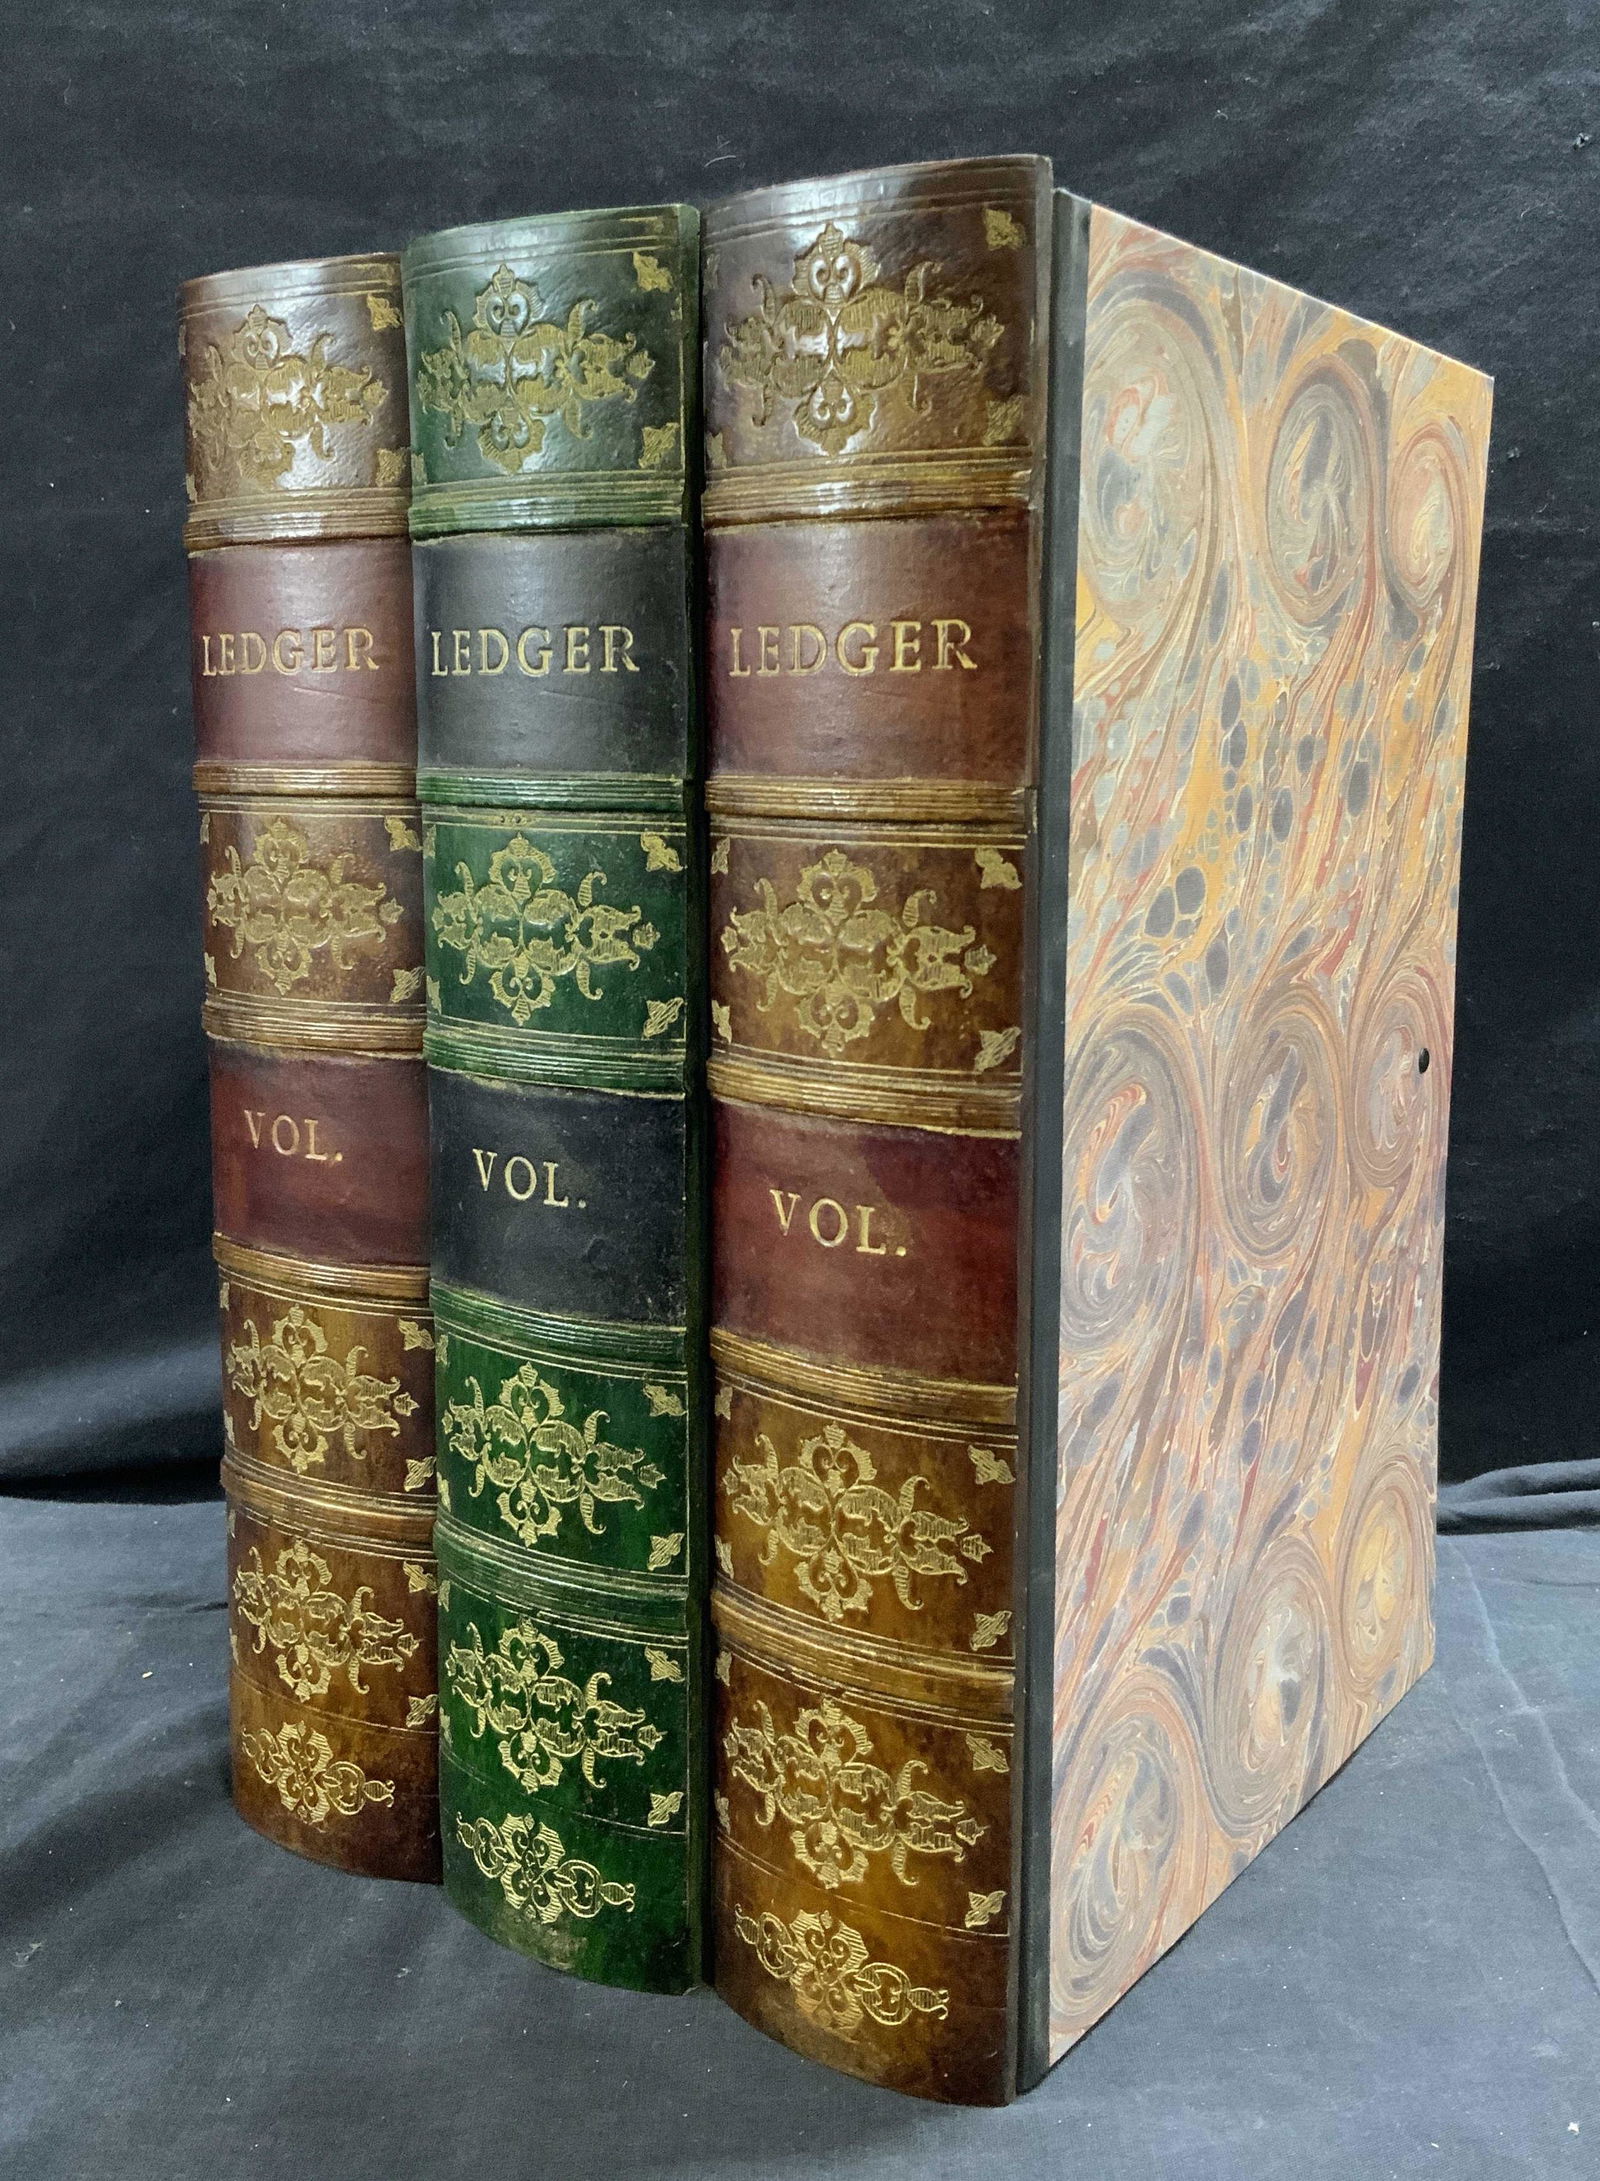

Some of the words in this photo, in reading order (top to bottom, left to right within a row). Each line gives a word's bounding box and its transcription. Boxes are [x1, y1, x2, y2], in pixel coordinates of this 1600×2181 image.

[202, 628, 380, 676] LEDGER
[431, 625, 640, 677] LEDGER
[729, 619, 978, 677] LEDGER
[244, 1109, 343, 1162] VOL.
[472, 1148, 587, 1209] VOL.
[769, 1189, 907, 1257] VOL.
